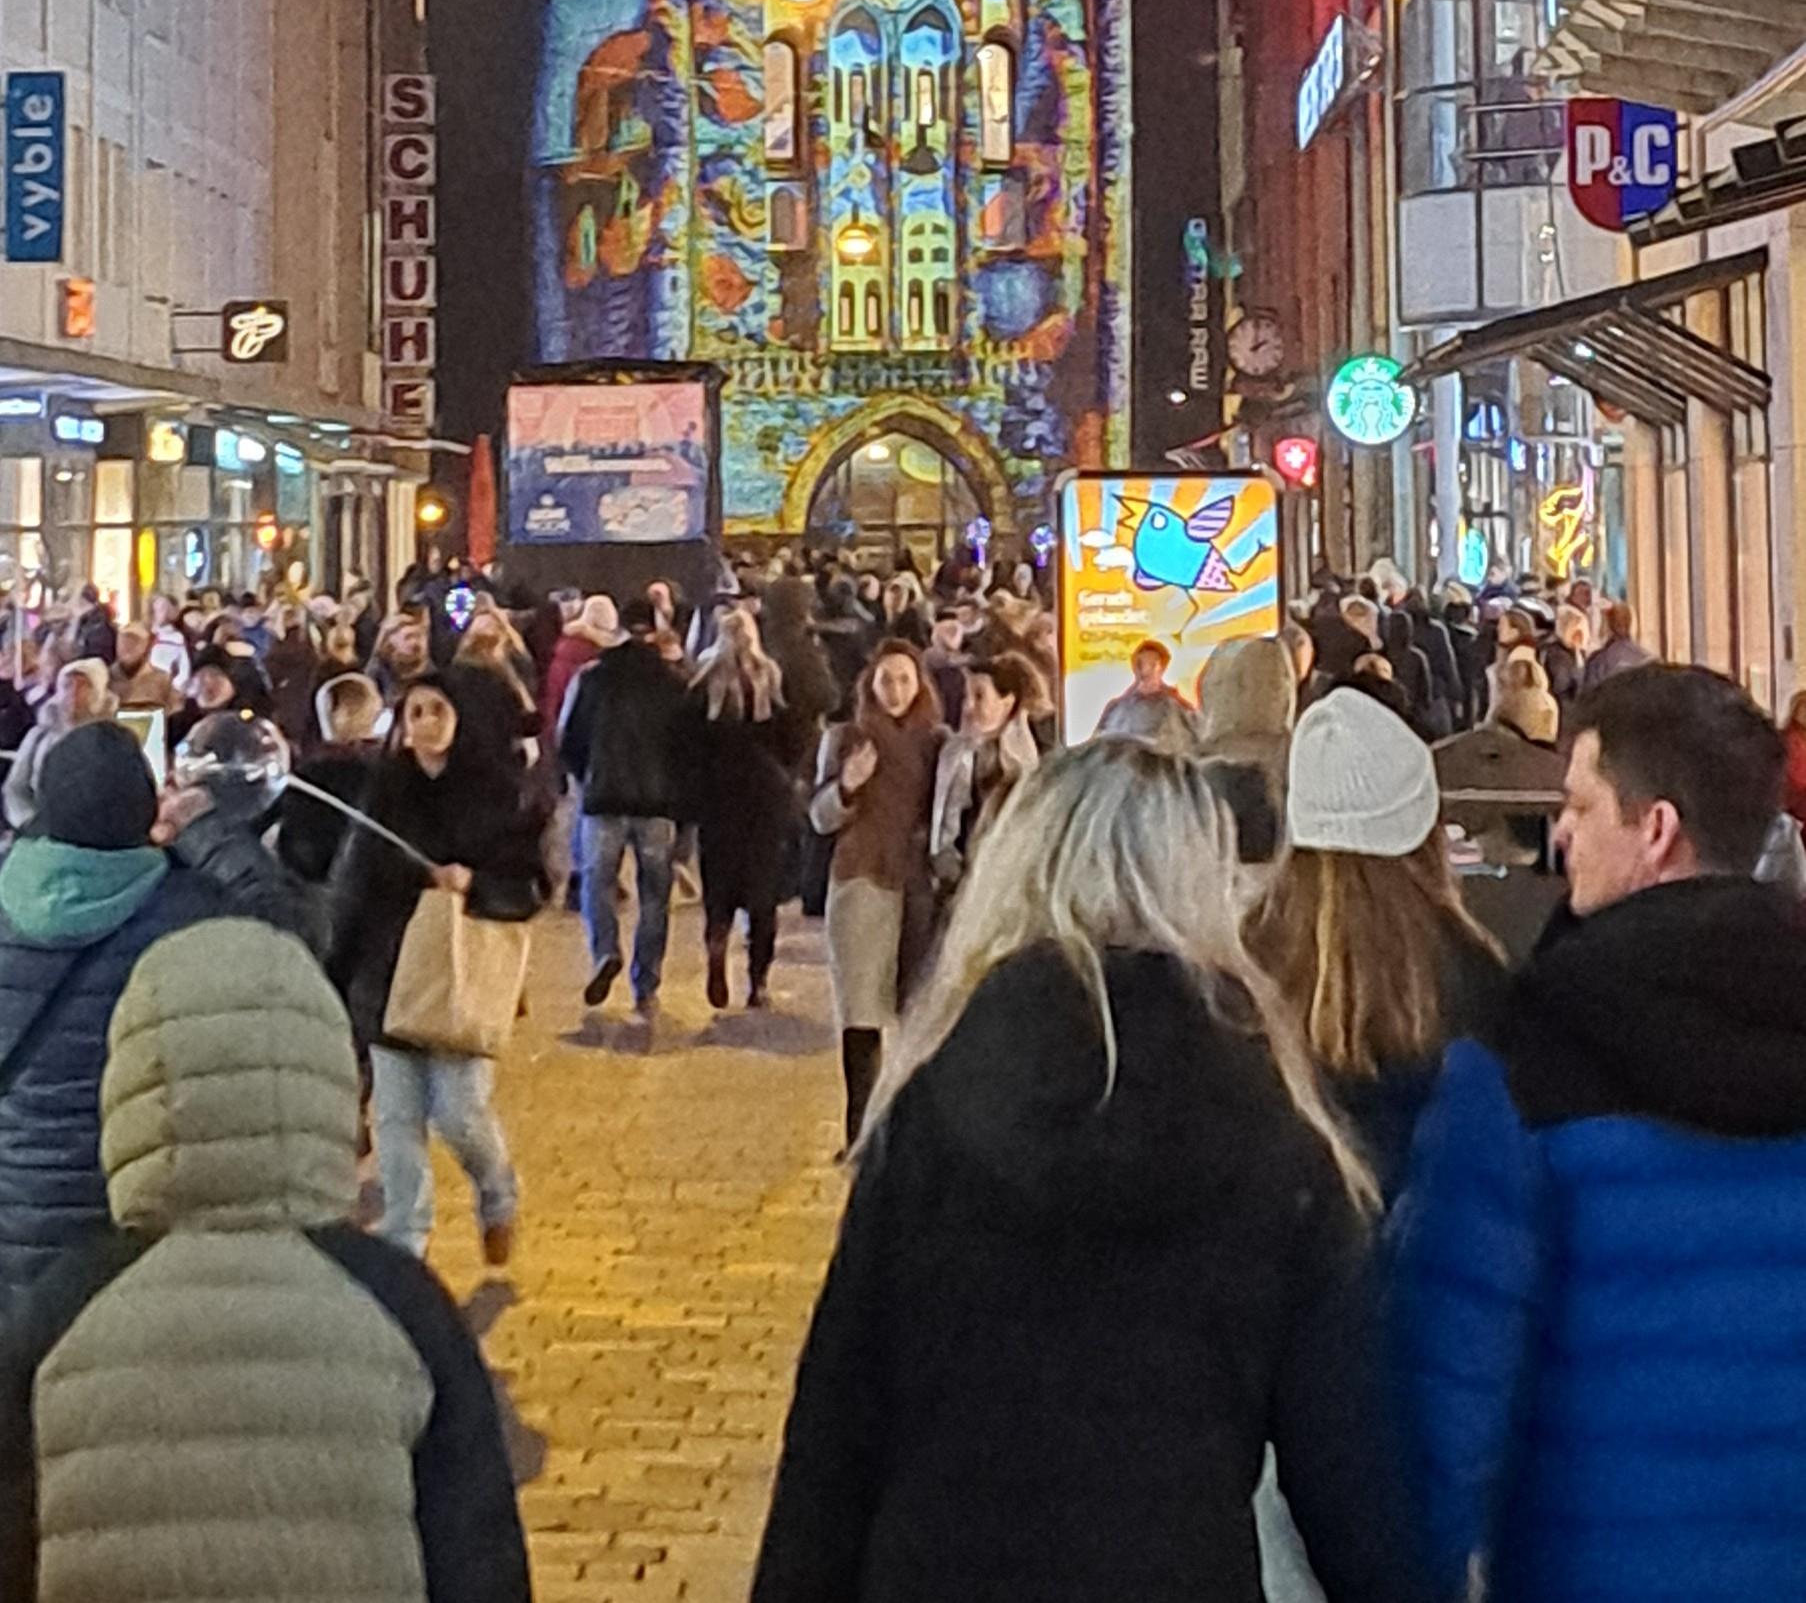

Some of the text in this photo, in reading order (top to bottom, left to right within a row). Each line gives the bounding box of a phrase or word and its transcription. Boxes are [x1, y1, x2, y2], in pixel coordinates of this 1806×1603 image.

[12, 94, 60, 241] vyble
[1575, 123, 1671, 186] P&C
[388, 76, 429, 416] SCHUHE
